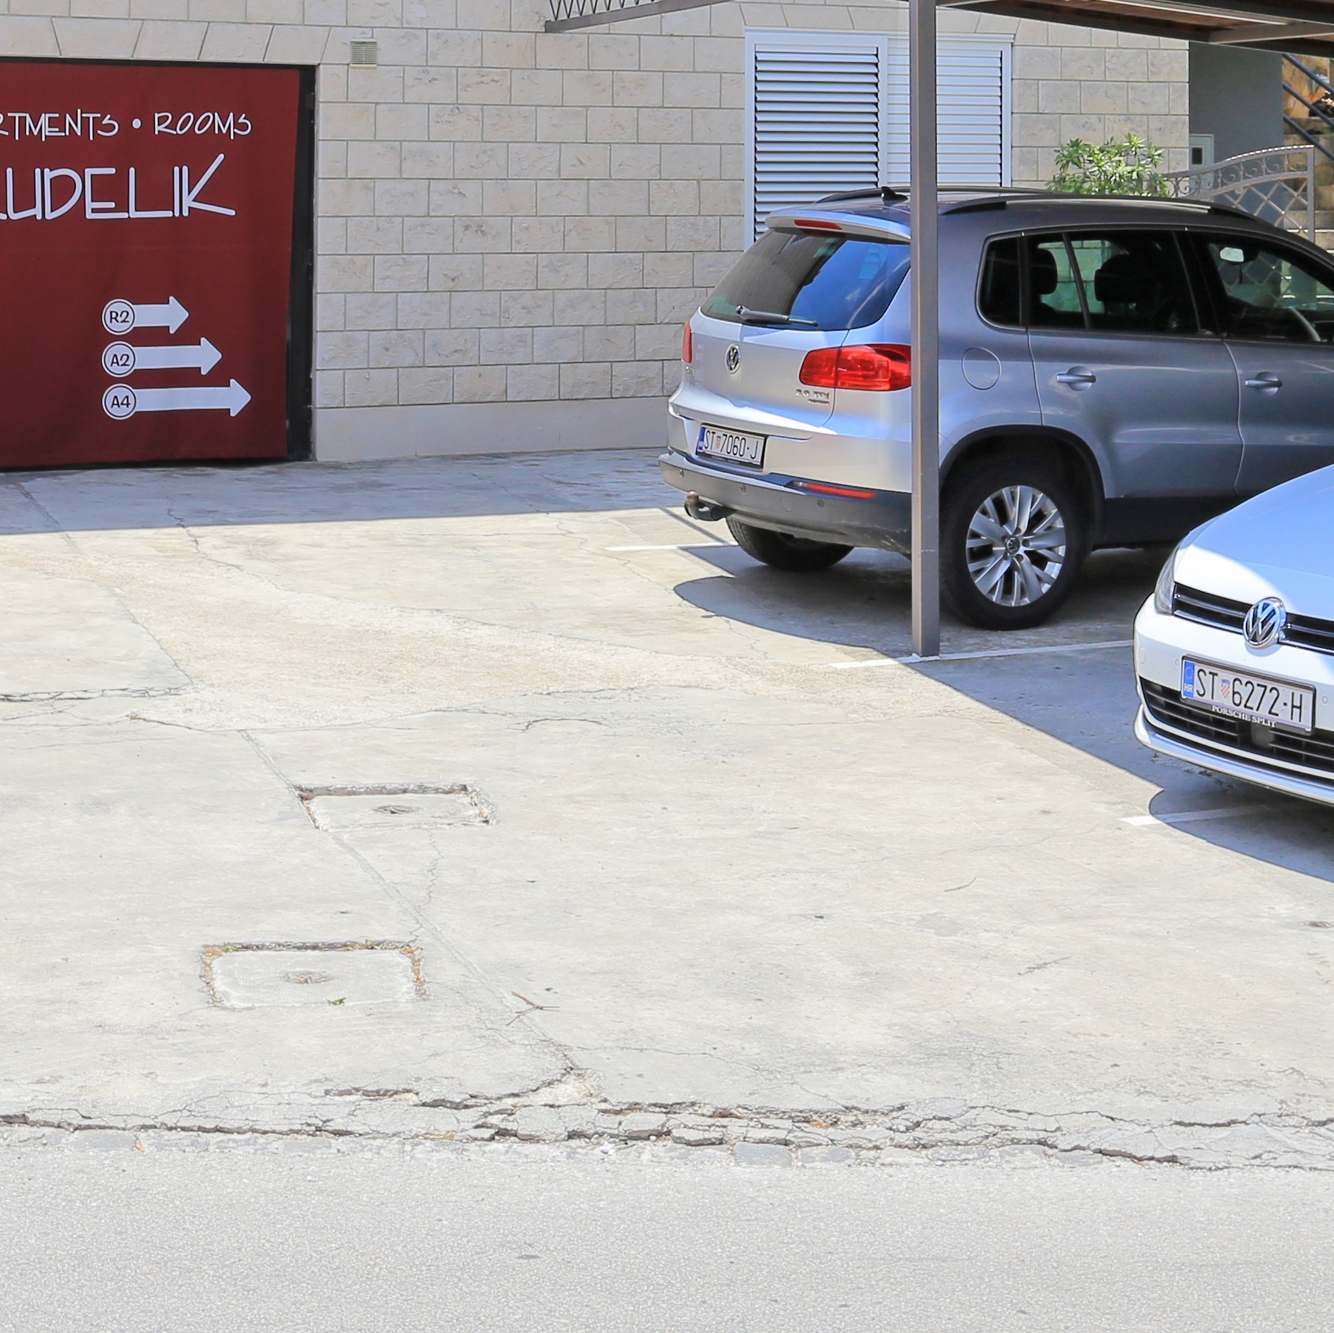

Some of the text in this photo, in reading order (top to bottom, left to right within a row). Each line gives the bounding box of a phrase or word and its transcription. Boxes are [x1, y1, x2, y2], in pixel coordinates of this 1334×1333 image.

[153, 111, 253, 140] ROOMS
[109, 309, 130, 324] R2
[110, 353, 130, 367] A2
[110, 395, 131, 409] A4
[703, 429, 716, 451] ST
[1196, 668, 1219, 700] ST
[1211, 705, 1276, 728] PORSCHE SPLIT
